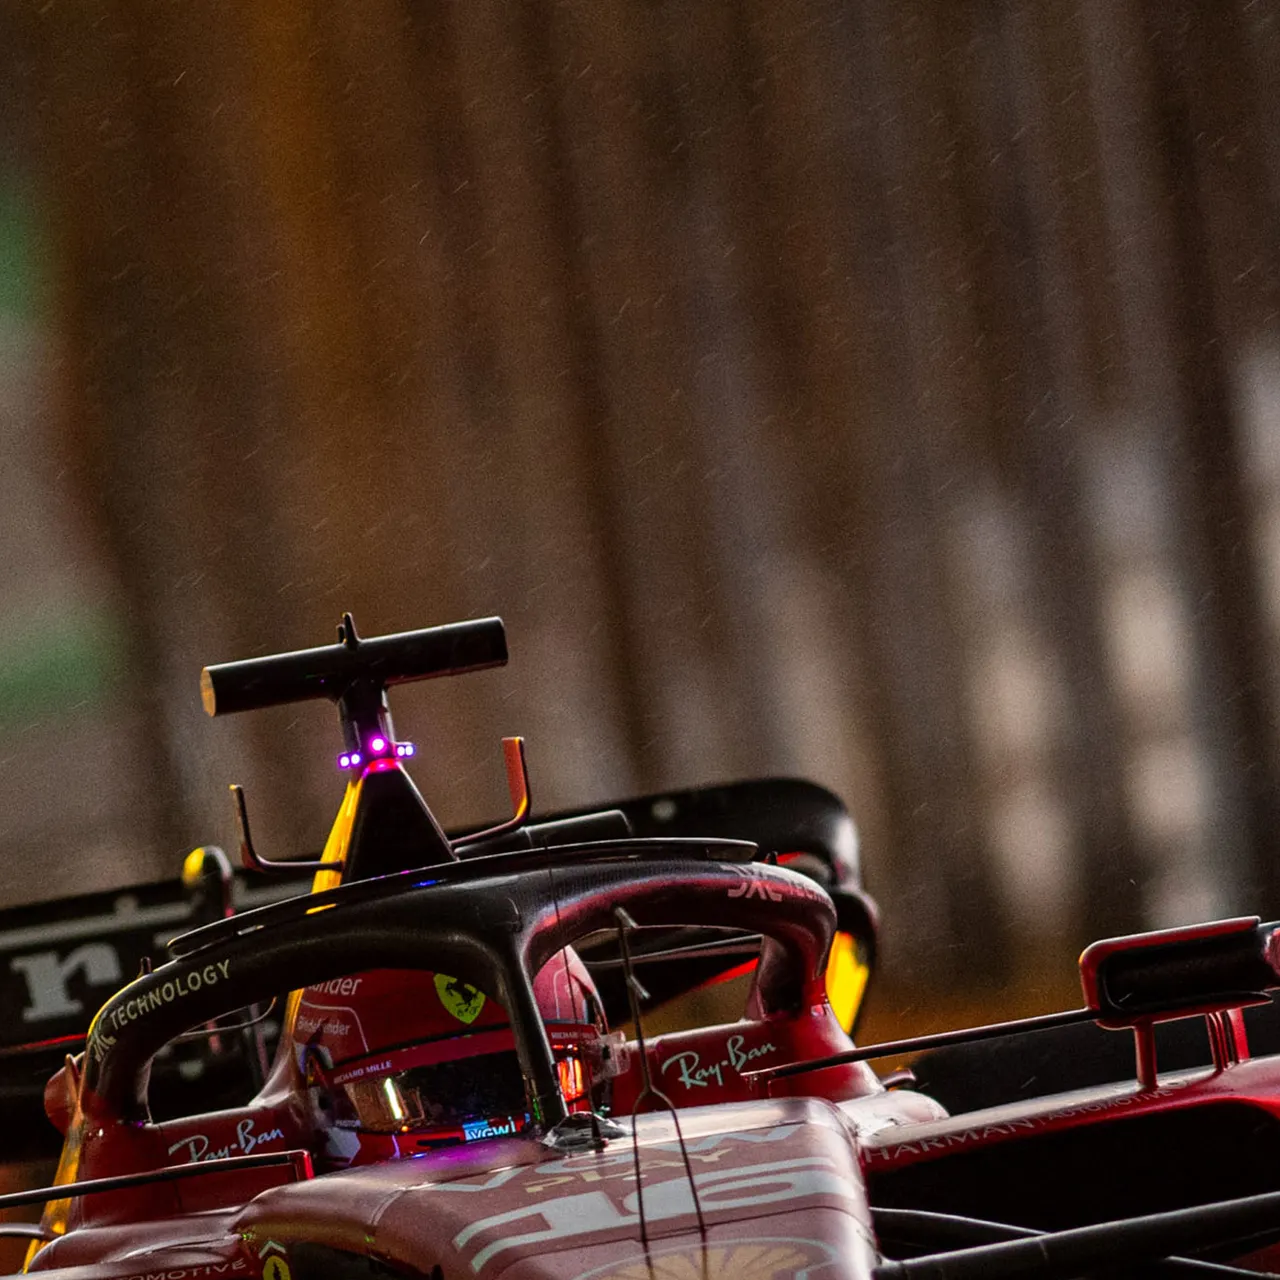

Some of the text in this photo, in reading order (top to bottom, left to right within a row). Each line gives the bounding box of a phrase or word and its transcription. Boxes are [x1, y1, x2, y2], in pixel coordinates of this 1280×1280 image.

[110, 958, 232, 1032] TECHNOLOGY
[662, 1035, 777, 1091] Ray-Ban
[167, 1118, 285, 1163] Ray-Ban
[864, 1116, 1035, 1164] HARMAN
